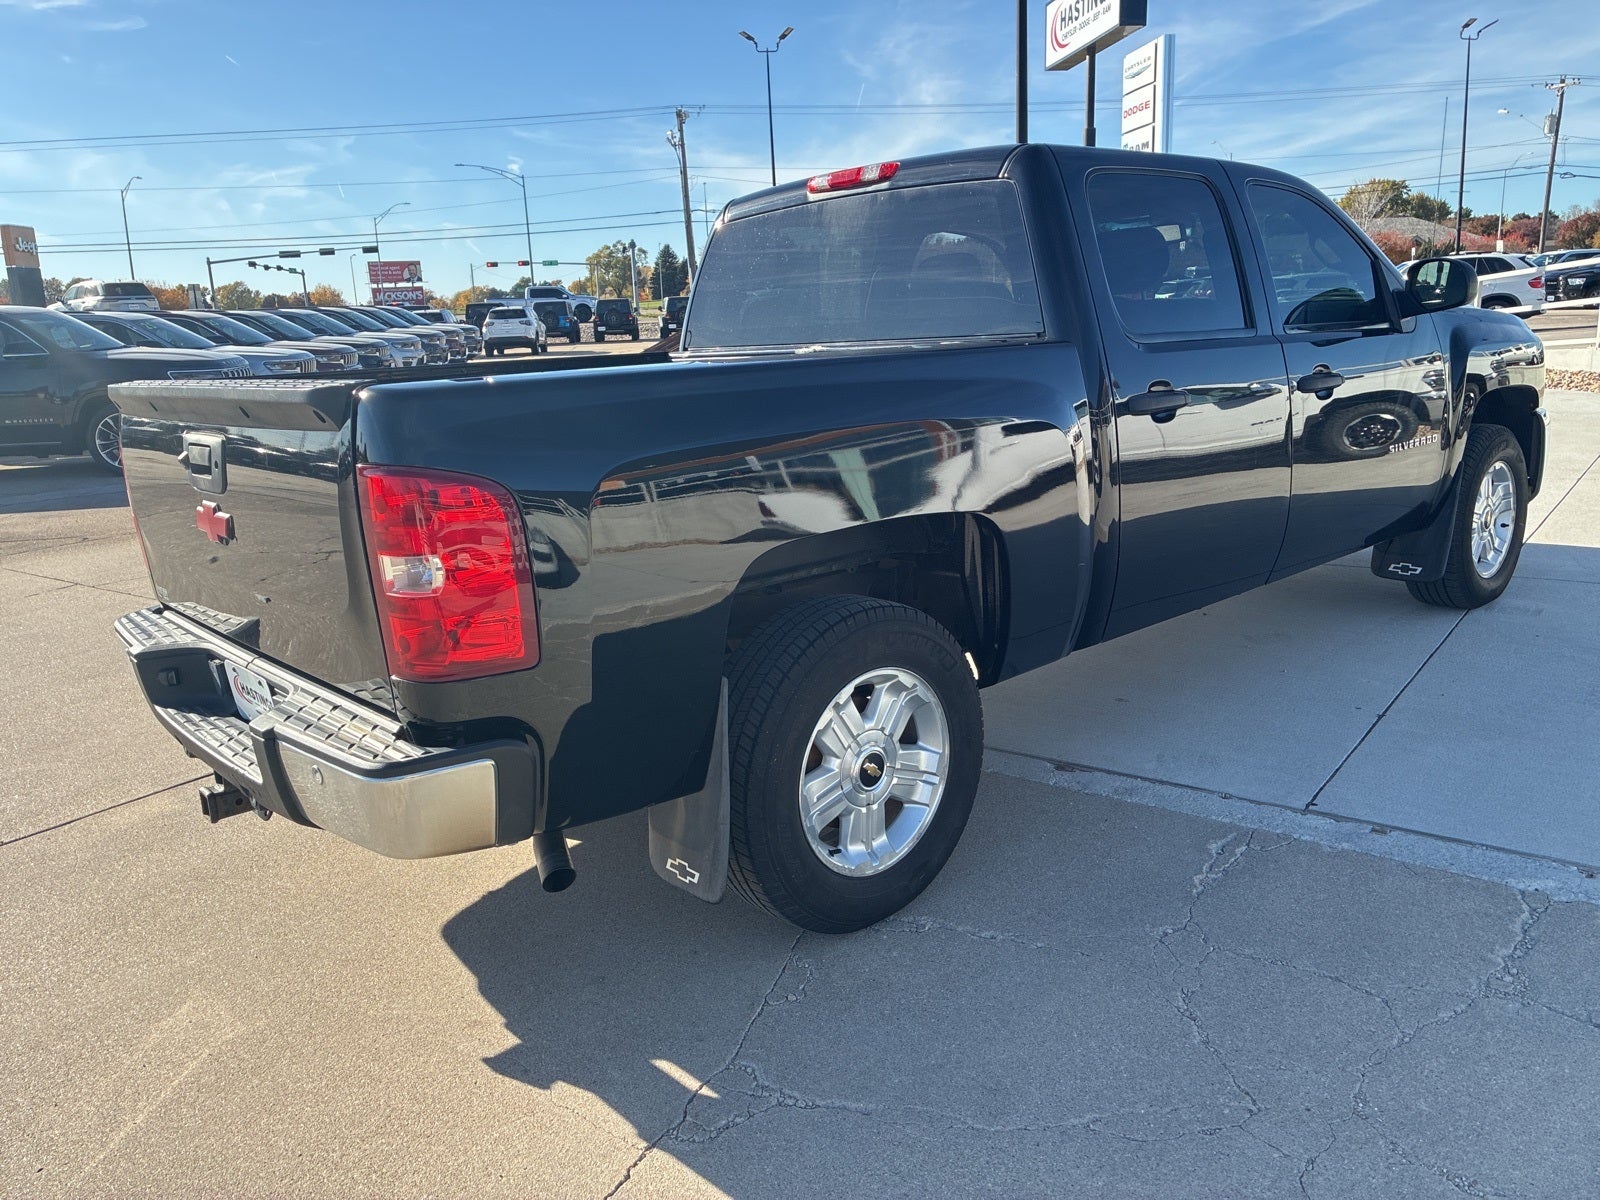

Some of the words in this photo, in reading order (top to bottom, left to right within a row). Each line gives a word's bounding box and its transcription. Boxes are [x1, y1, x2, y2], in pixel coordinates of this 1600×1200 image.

[1060, 0, 1106, 31] HASTIN
[1124, 55, 1152, 73] CHRYSLER
[1123, 99, 1151, 119] DODGE
[15, 236, 38, 256] Jeep
[1389, 434, 1438, 453] SILVERADO
